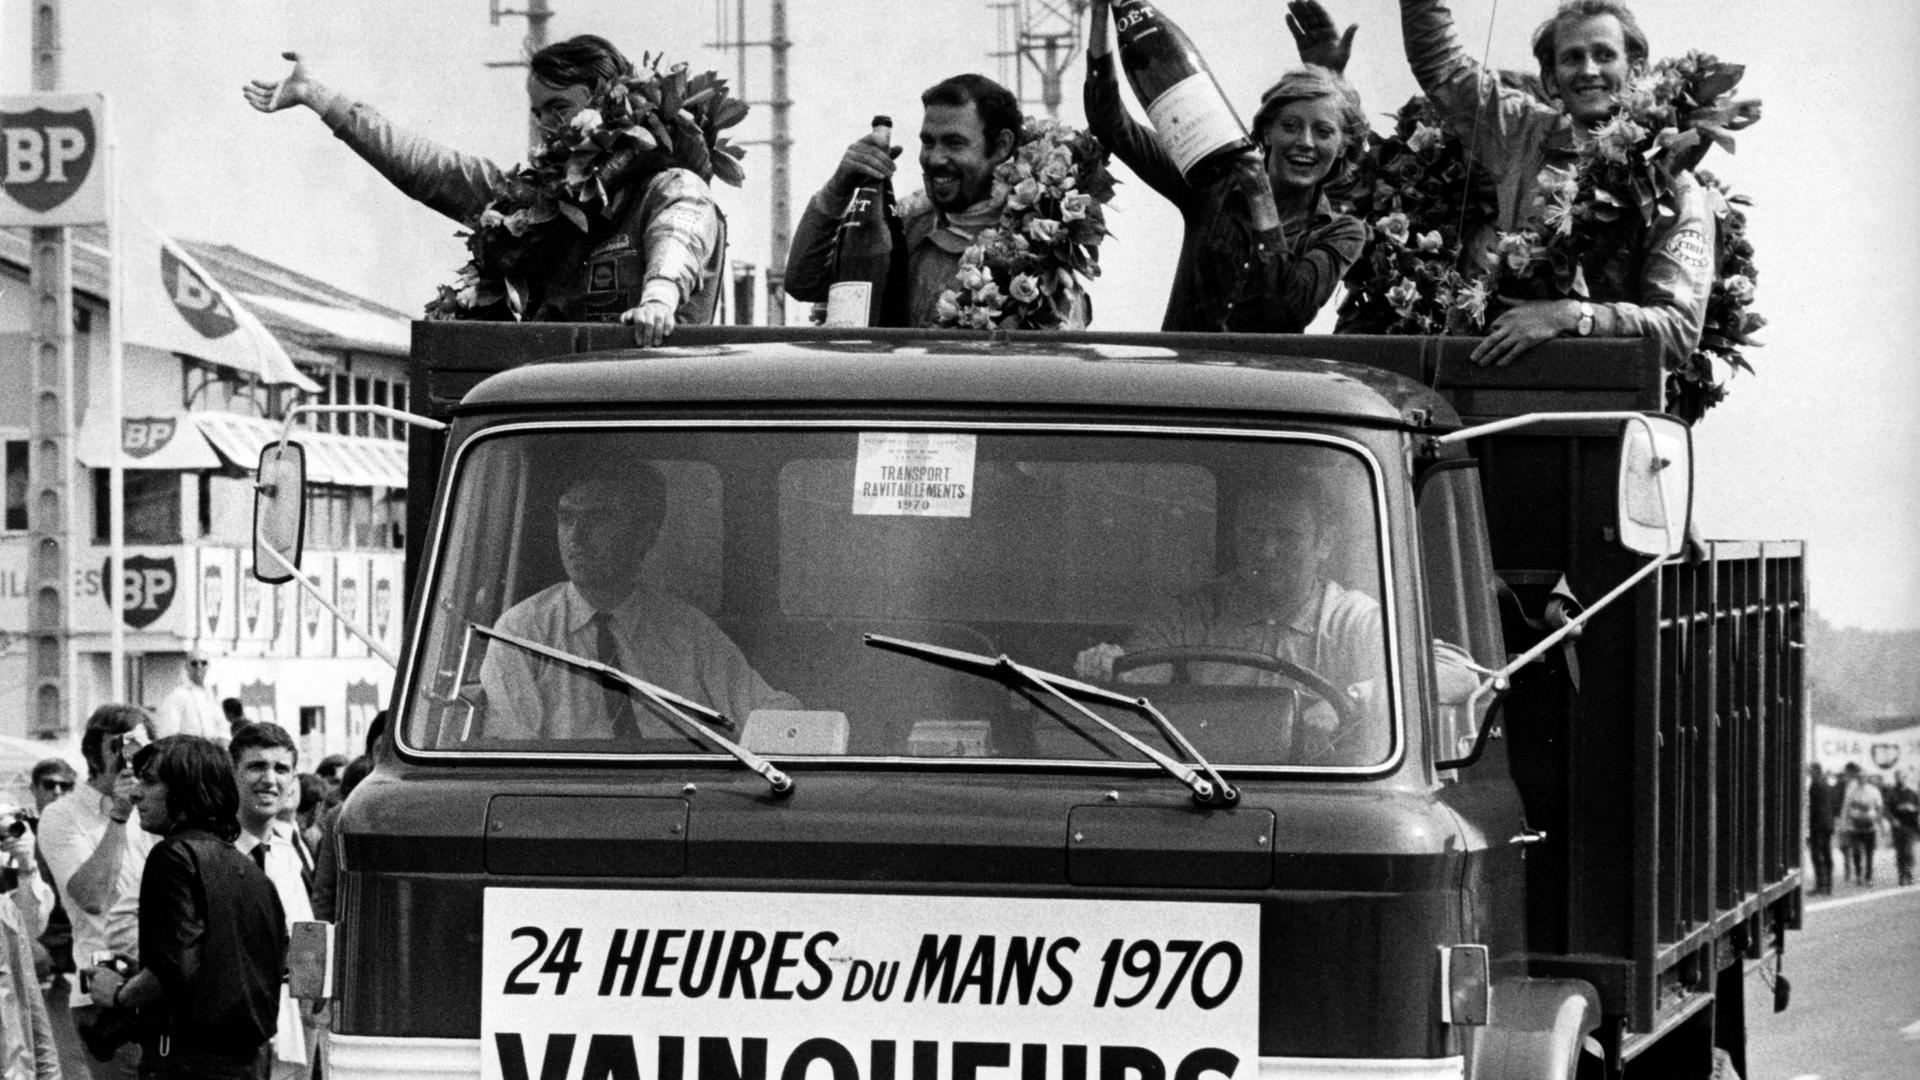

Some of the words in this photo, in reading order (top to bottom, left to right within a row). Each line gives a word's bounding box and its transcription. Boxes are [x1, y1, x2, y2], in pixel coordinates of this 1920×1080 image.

[2, 126, 86, 183] BP
[124, 422, 171, 449] BP
[881, 466, 952, 482] TRANSPORT
[862, 481, 966, 499] RAVITAILLEMENTS
[897, 500, 930, 510] 1970
[123, 568, 173, 611] BP
[503, 926, 583, 996] 24
[597, 927, 839, 1001] HEURES
[842, 959, 901, 1002] DU
[903, 933, 1081, 1006] MANS
[1093, 938, 1243, 1010] 1970
